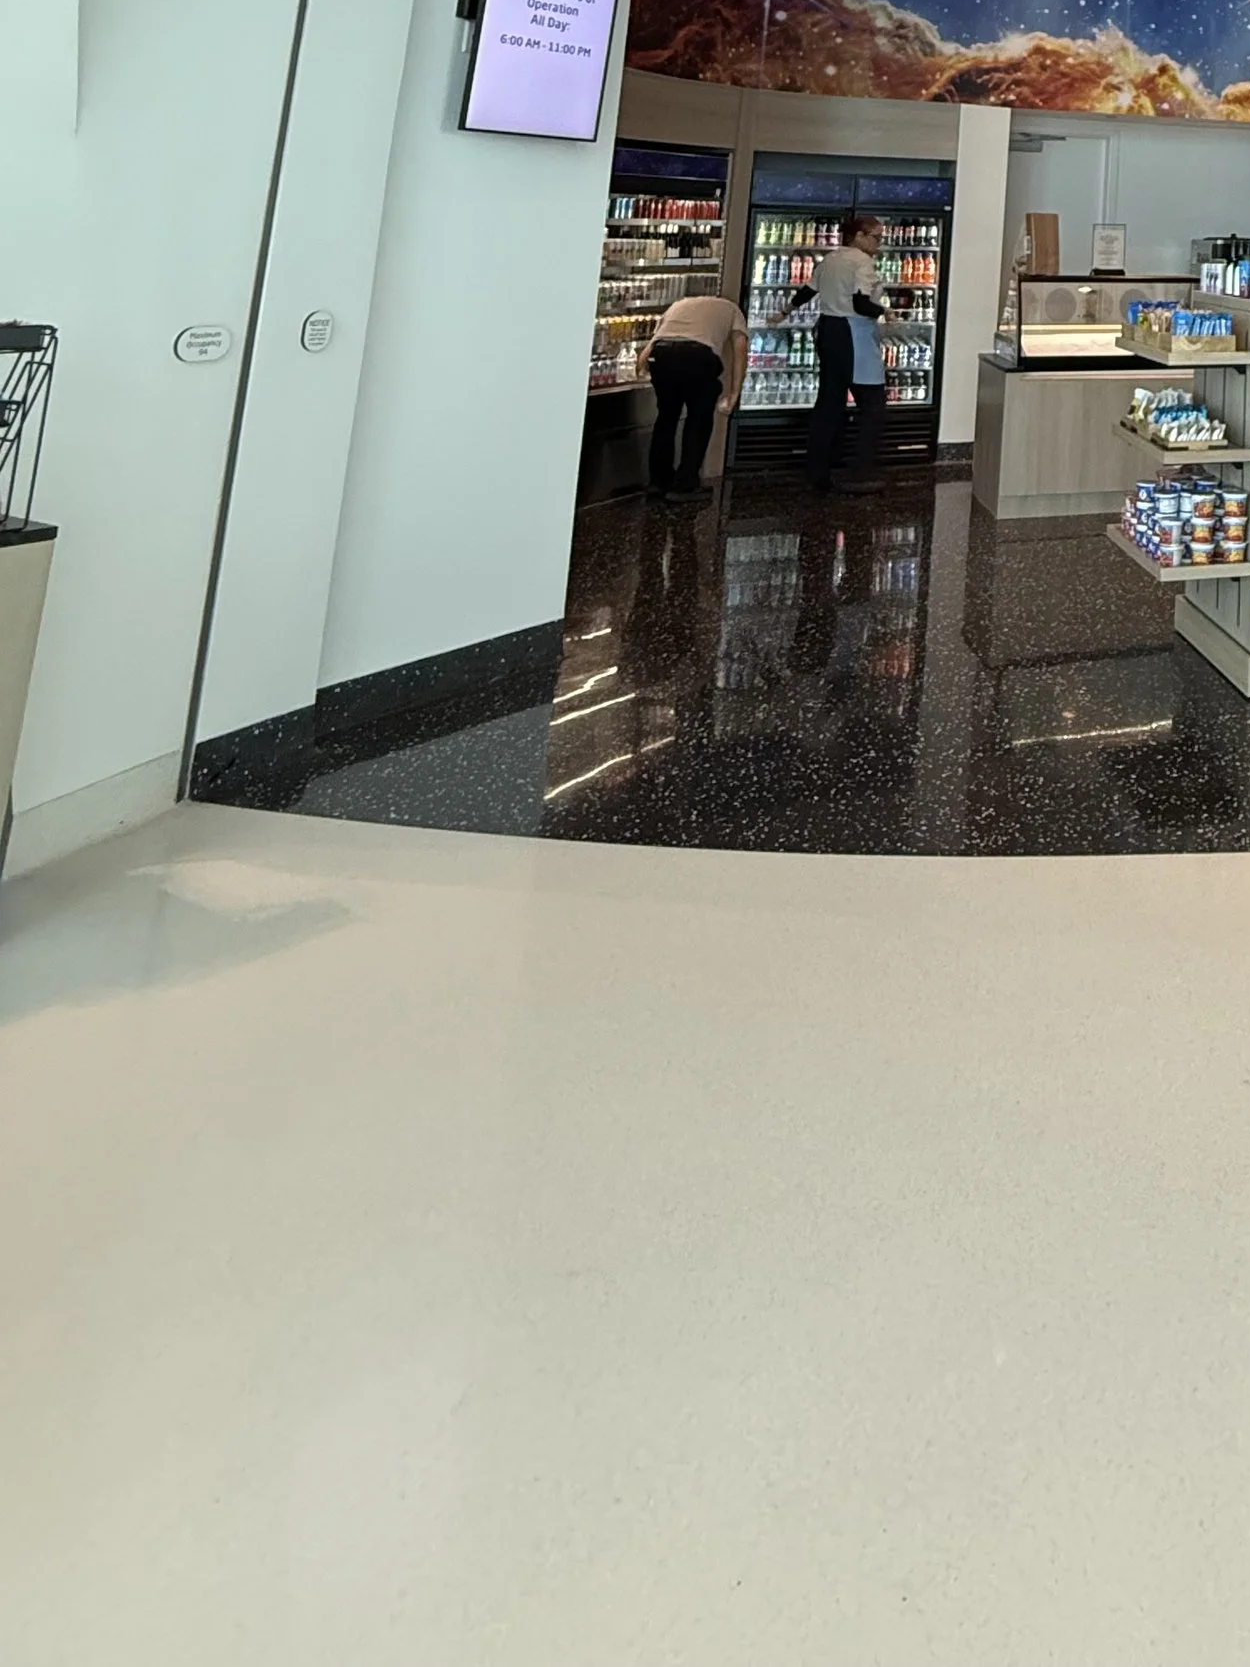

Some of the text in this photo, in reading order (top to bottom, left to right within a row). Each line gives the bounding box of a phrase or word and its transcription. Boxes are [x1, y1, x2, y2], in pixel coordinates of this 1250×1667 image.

[530, 14, 571, 32] All Day:
[500, 34, 524, 47] 6:00
[525, 38, 541, 49] AM
[549, 42, 576, 55] 11:00
[577, 46, 592, 57] PM
